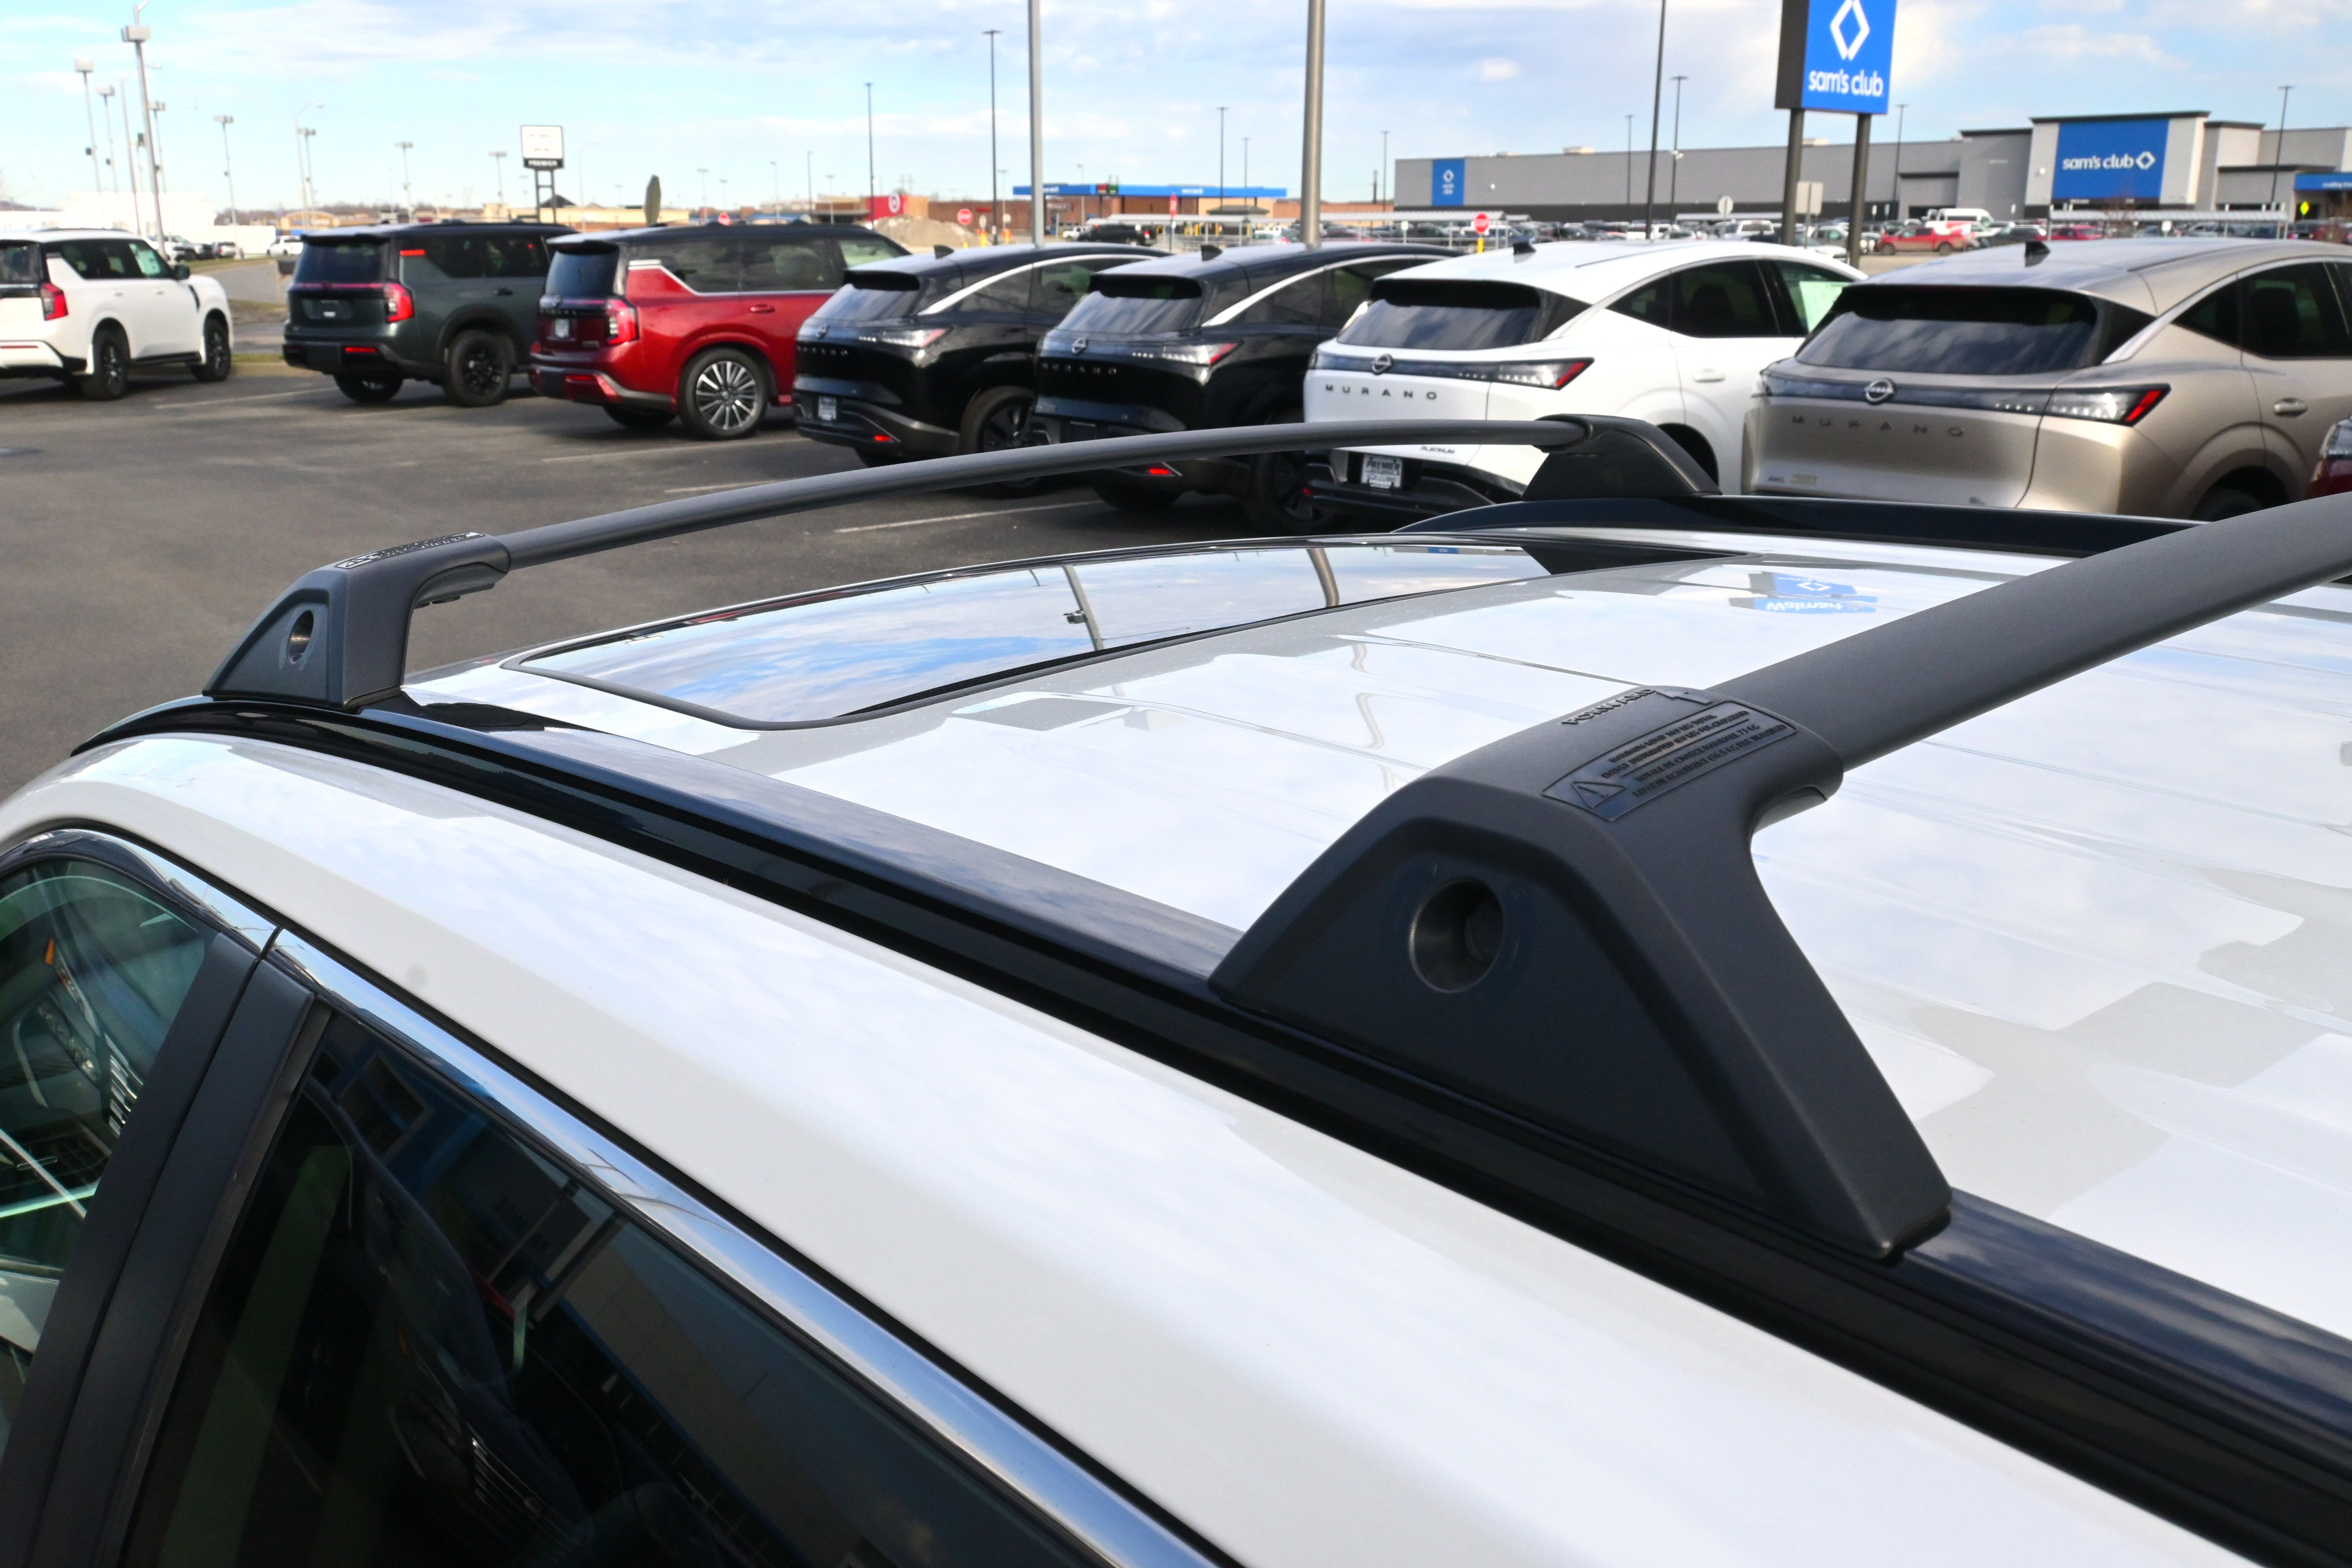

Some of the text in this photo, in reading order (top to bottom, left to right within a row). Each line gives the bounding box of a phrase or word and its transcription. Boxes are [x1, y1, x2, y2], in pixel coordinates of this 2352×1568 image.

[1808, 68, 1884, 97] sam's club
[2062, 153, 2134, 170] sam's club
[1325, 384, 1437, 400] MURANO
[1792, 414, 1964, 437] MURANO
[1561, 689, 1656, 724] FORWARD
